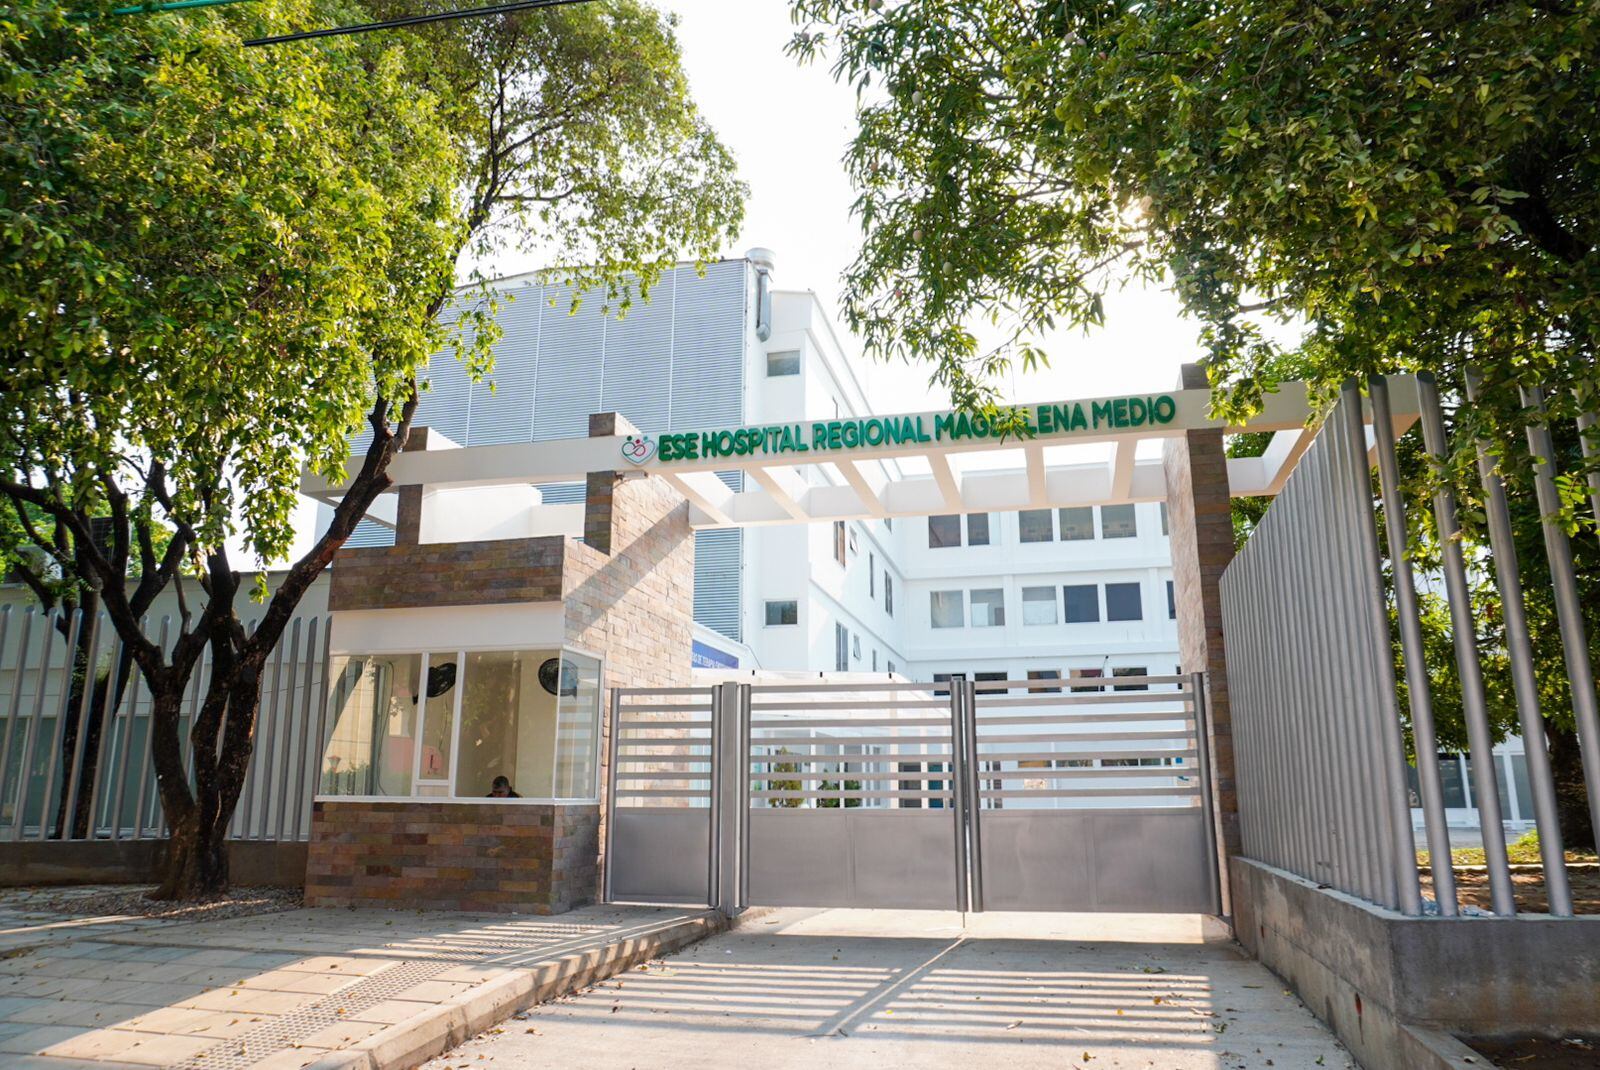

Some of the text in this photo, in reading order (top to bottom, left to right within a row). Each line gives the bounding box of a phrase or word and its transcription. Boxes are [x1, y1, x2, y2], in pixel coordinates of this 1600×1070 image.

[658, 395, 1176, 462] ESE HOSPITAL REGIONAL MAGDLENA MEDIO
